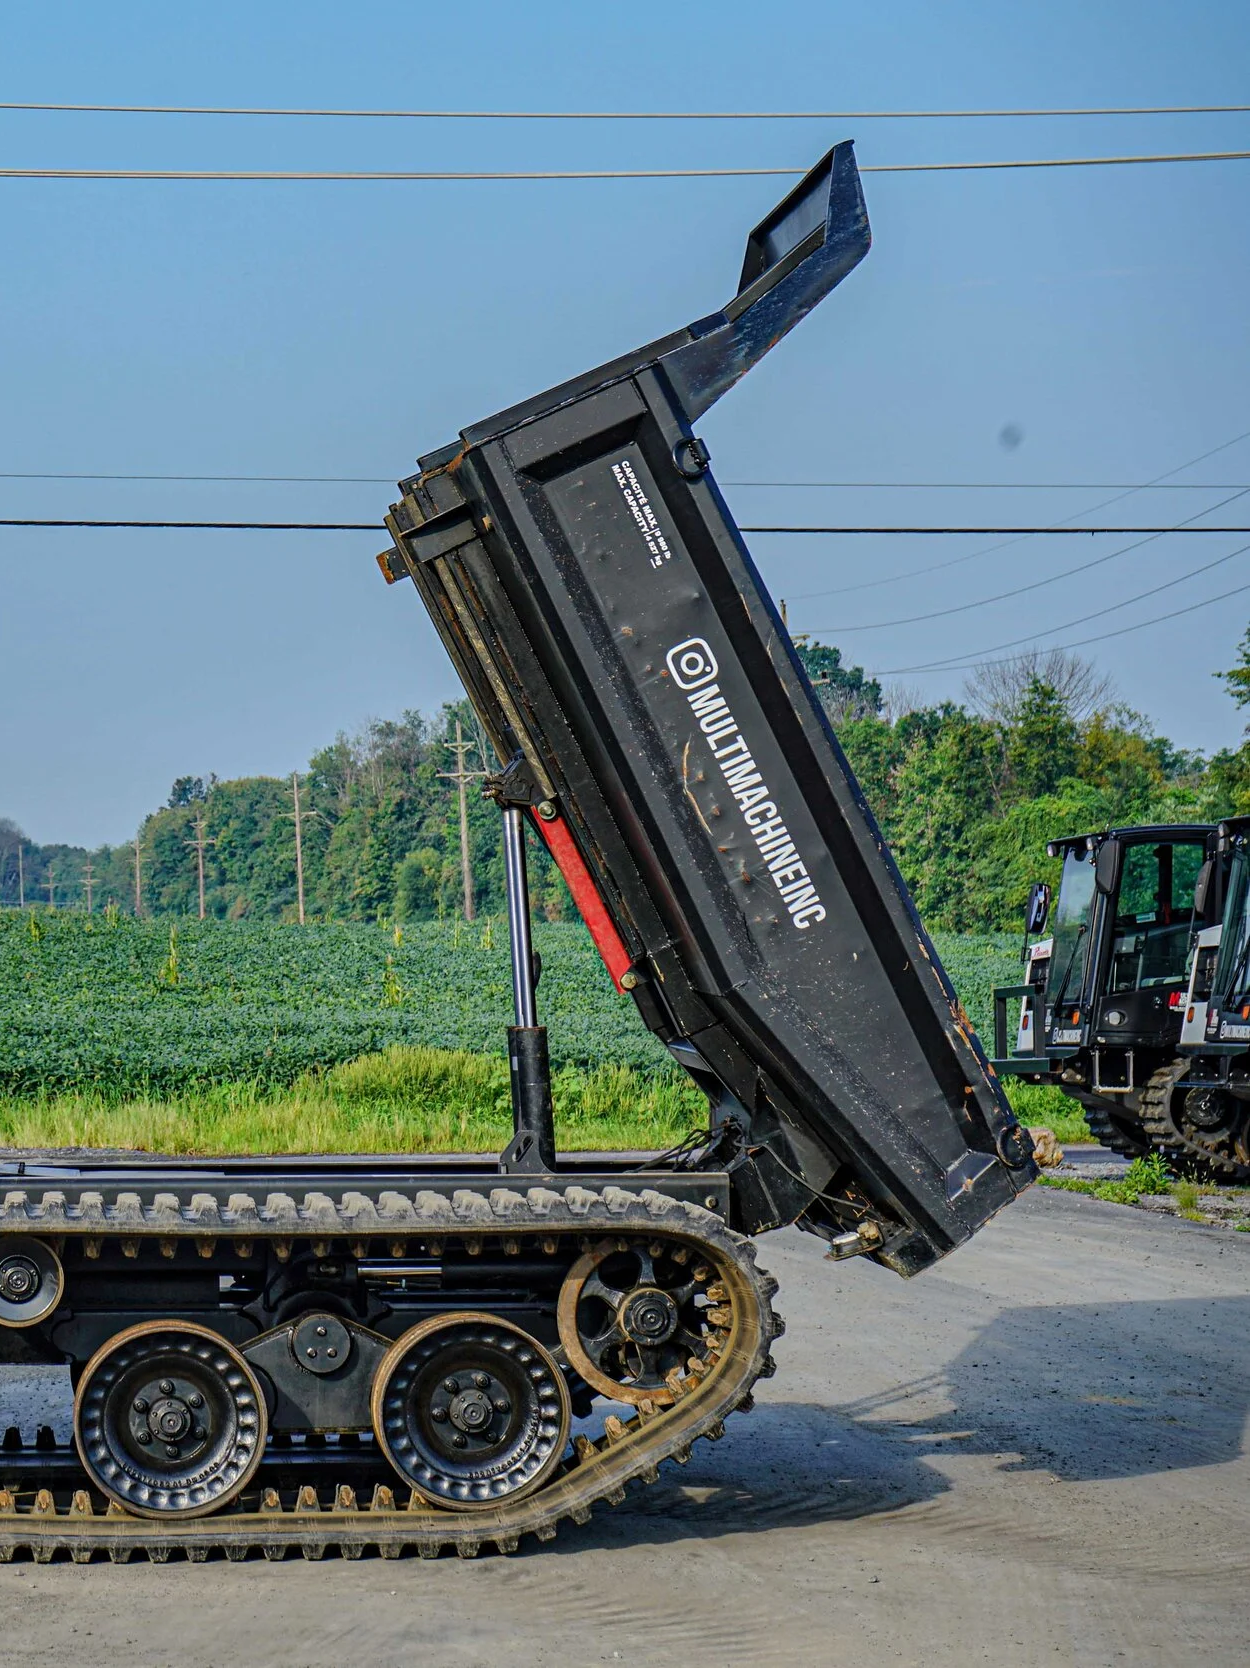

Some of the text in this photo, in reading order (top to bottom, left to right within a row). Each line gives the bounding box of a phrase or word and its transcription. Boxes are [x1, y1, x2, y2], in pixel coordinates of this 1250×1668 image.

[611, 464, 628, 489] MAX.
[623, 489, 650, 534] CAPACITY
[621, 460, 649, 506] CAPACITÉ
[642, 505, 658, 529] MAX.
[687, 683, 827, 930] MULTIMACHINEINC
